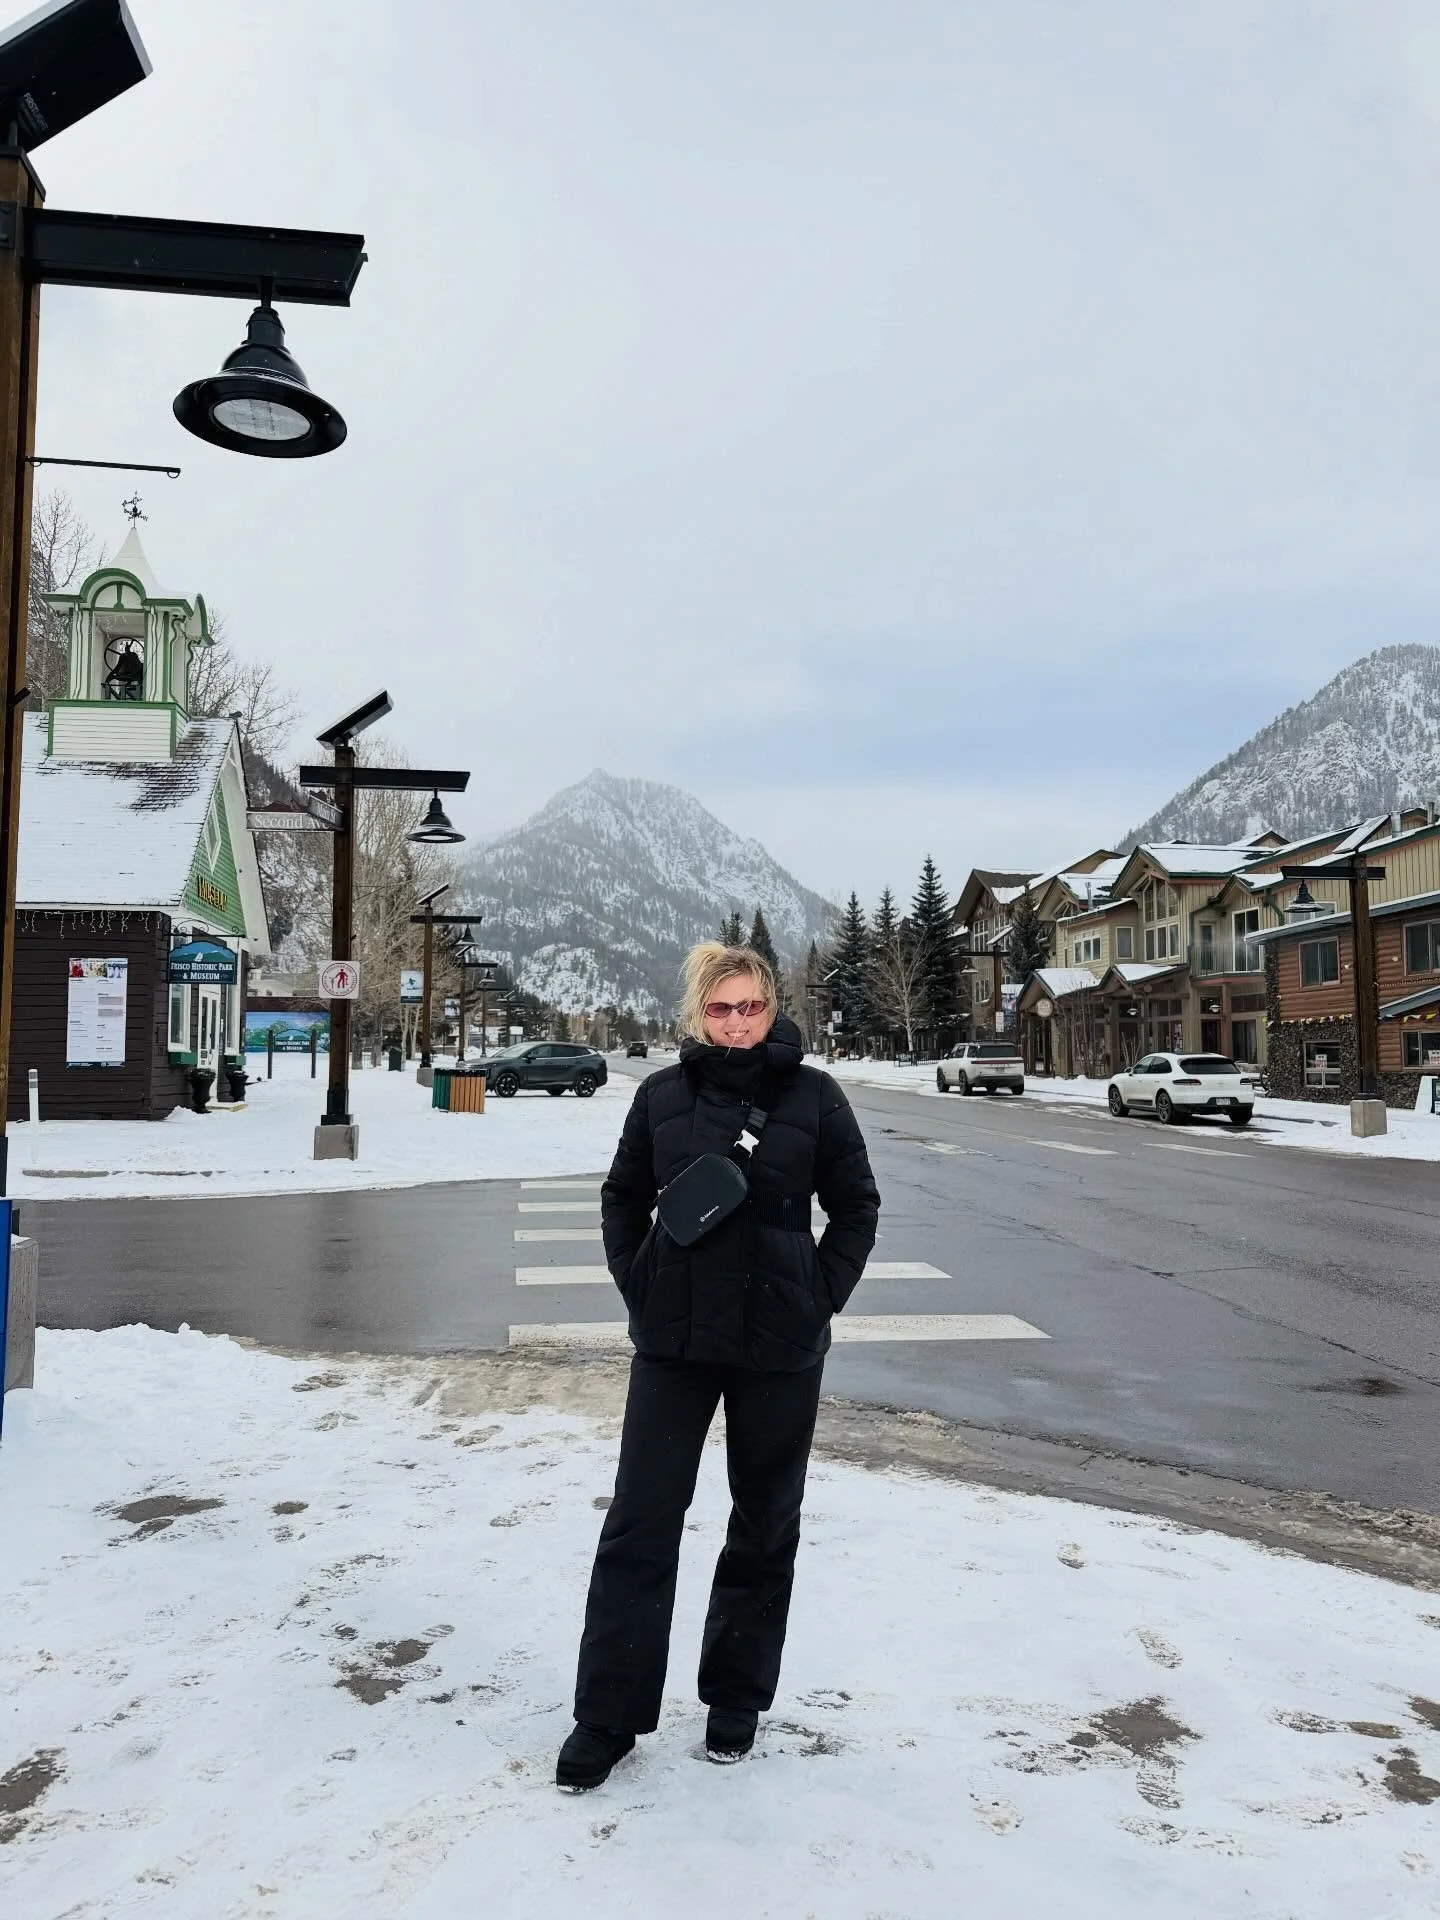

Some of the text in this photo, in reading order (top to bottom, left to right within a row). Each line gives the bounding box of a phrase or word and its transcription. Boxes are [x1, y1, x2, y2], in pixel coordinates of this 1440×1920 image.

[316, 802, 336, 824] Main St
[255, 814, 303, 828] Second
[170, 962, 233, 970] FRISCO HISTORIC PARK
[182, 971, 220, 980] & MUSEUM
